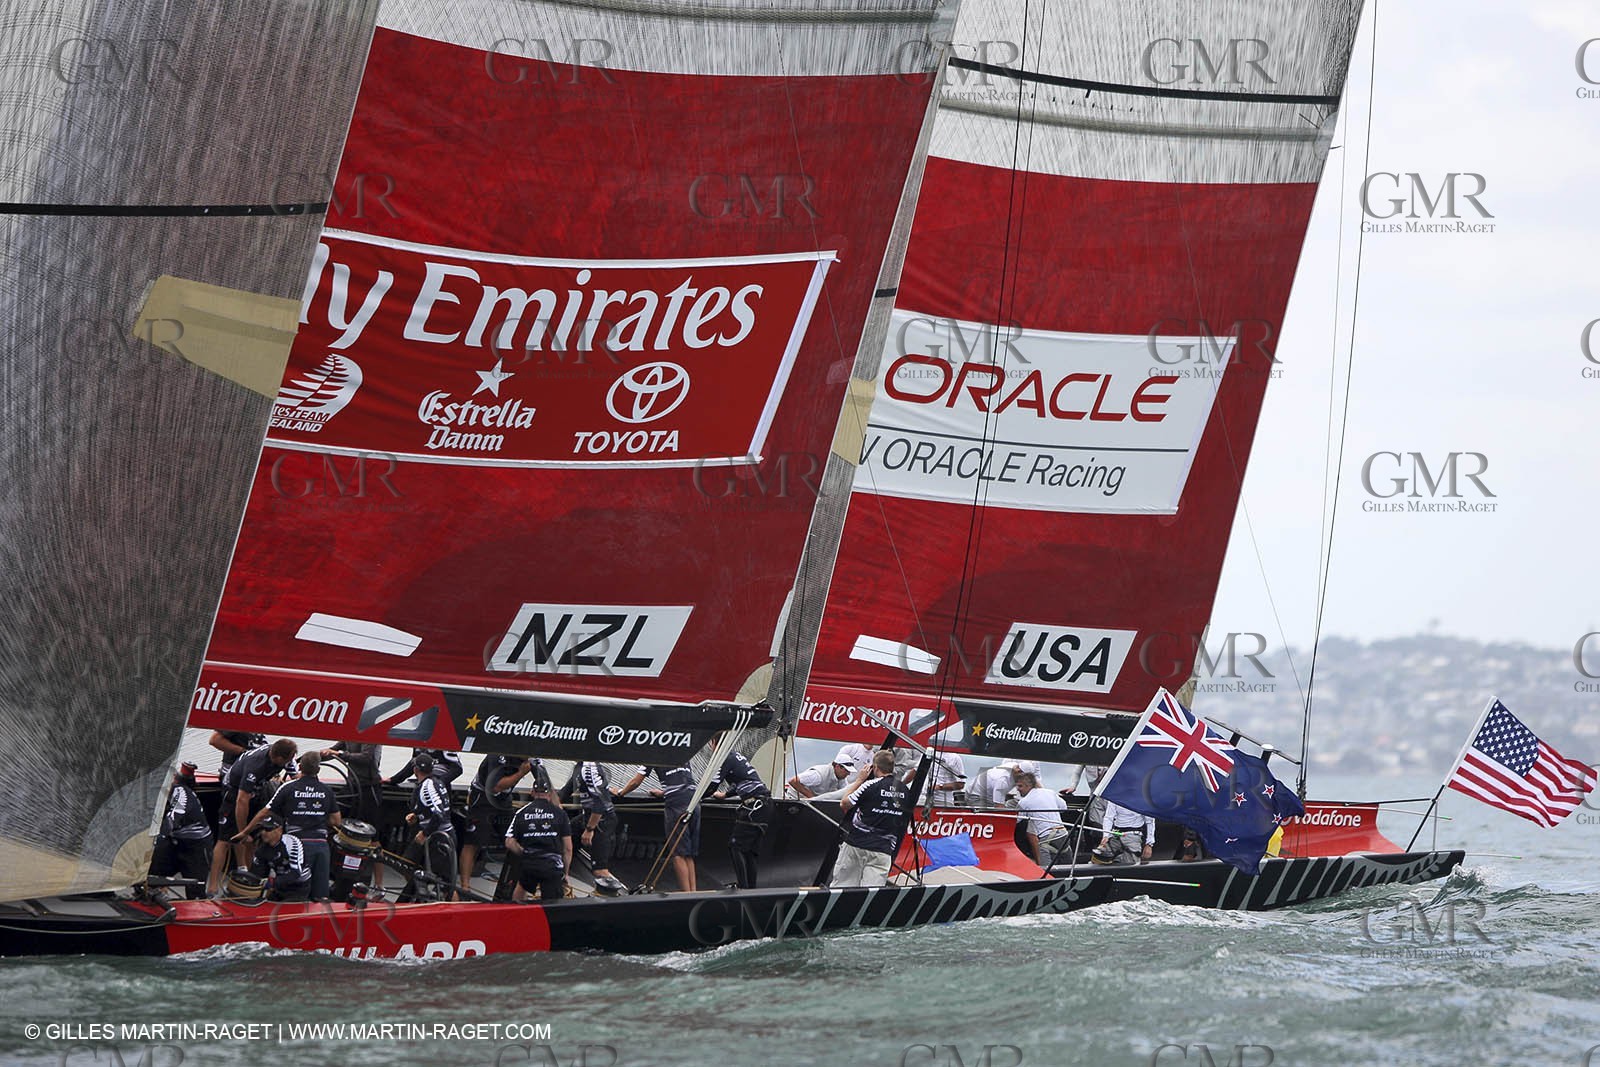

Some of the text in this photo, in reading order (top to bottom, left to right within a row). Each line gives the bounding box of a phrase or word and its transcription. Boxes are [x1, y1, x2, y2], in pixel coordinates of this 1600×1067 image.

[403, 262, 763, 351] Emirates
[418, 390, 536, 428] Estrella
[884, 354, 1179, 422] ORACLE
[424, 425, 504, 451] Damm
[573, 430, 679, 453] TOYOTA
[883, 438, 1027, 483] ORACLE
[1026, 454, 1126, 497] Racing
[506, 613, 654, 668] NZL
[1000, 630, 1112, 685] USA
[627, 729, 691, 747] TOYOTA
